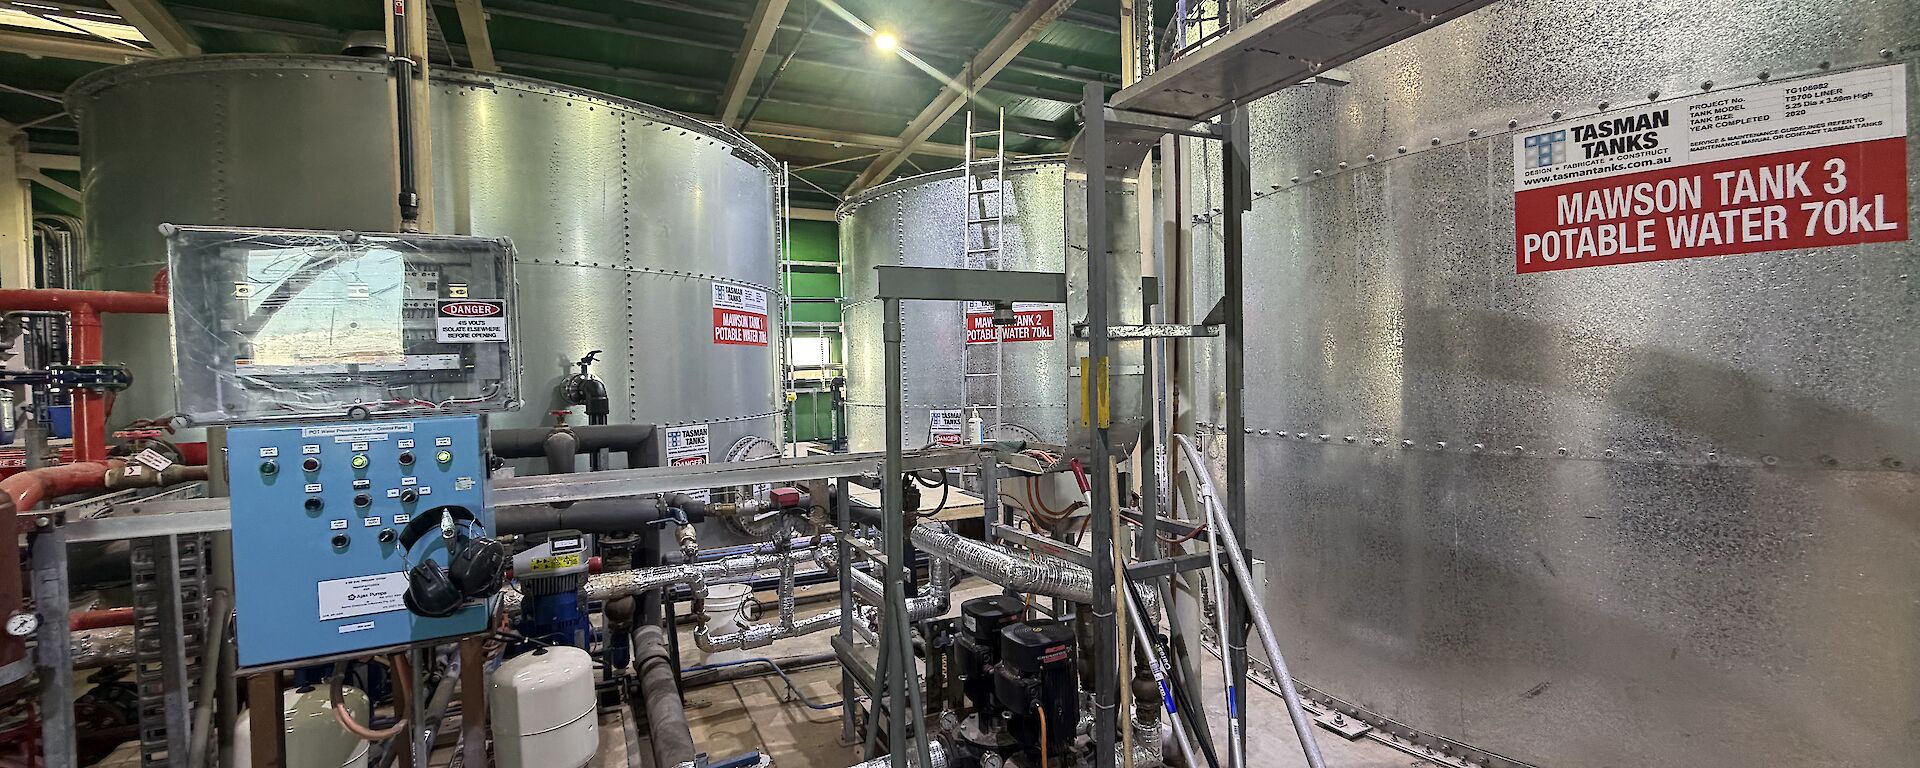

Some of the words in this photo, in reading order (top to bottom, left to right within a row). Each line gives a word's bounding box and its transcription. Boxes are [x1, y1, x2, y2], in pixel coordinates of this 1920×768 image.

[1814, 88, 1843, 98] LINER
[1853, 91, 1874, 100] High
[1689, 99, 1729, 111] PROJECT
[1689, 110, 1713, 118] TANK
[1714, 105, 1746, 114] MODEL
[1785, 109, 1806, 118] 2020
[1571, 109, 1669, 143] TASMAN
[1689, 117, 1713, 126] TANK
[1689, 124, 1713, 132] YEAR
[1715, 115, 1770, 128] COMPLETED
[1689, 141, 1740, 152] MAINTENANCE
[1741, 136, 1772, 145] MANUAL
[1785, 129, 1821, 139] CONTACT
[1823, 125, 1855, 133] TASMAN
[1857, 120, 1883, 129] TANKS
[1690, 139, 1719, 147] SERVICE
[1727, 130, 1779, 141] MAINTENANCE
[1780, 122, 1826, 133] GUIDELINES
[1827, 119, 1852, 127] REFER
[1581, 131, 1659, 160] TANKS
[1524, 167, 1552, 177] DESIGN
[1563, 158, 1605, 170] FABRICATE
[1616, 148, 1669, 161] CONSTRUCT
[1523, 156, 1672, 186] www.tasmantanks.com.au
[1557, 175, 1702, 226] MAWSON
[1713, 160, 1812, 206] TANK
[1823, 157, 1847, 195] 3
[1523, 219, 1657, 264] POTABLE
[1666, 205, 1788, 249] WATER
[1800, 194, 1898, 237] 70kL
[725, 286, 743, 295] TASMAN
[727, 294, 742, 303] TANKS
[450, 305, 492, 314] DANGER
[722, 312, 749, 328] MAWSON
[748, 316, 760, 329] TANK
[1035, 314, 1042, 326] 2
[715, 327, 743, 341] POTABLE
[743, 329, 759, 343] WATER
[1001, 327, 1030, 339] WATER
[1031, 326, 1052, 338] 70kL
[682, 428, 708, 438] TASMAN
[685, 436, 706, 445] TANKS
